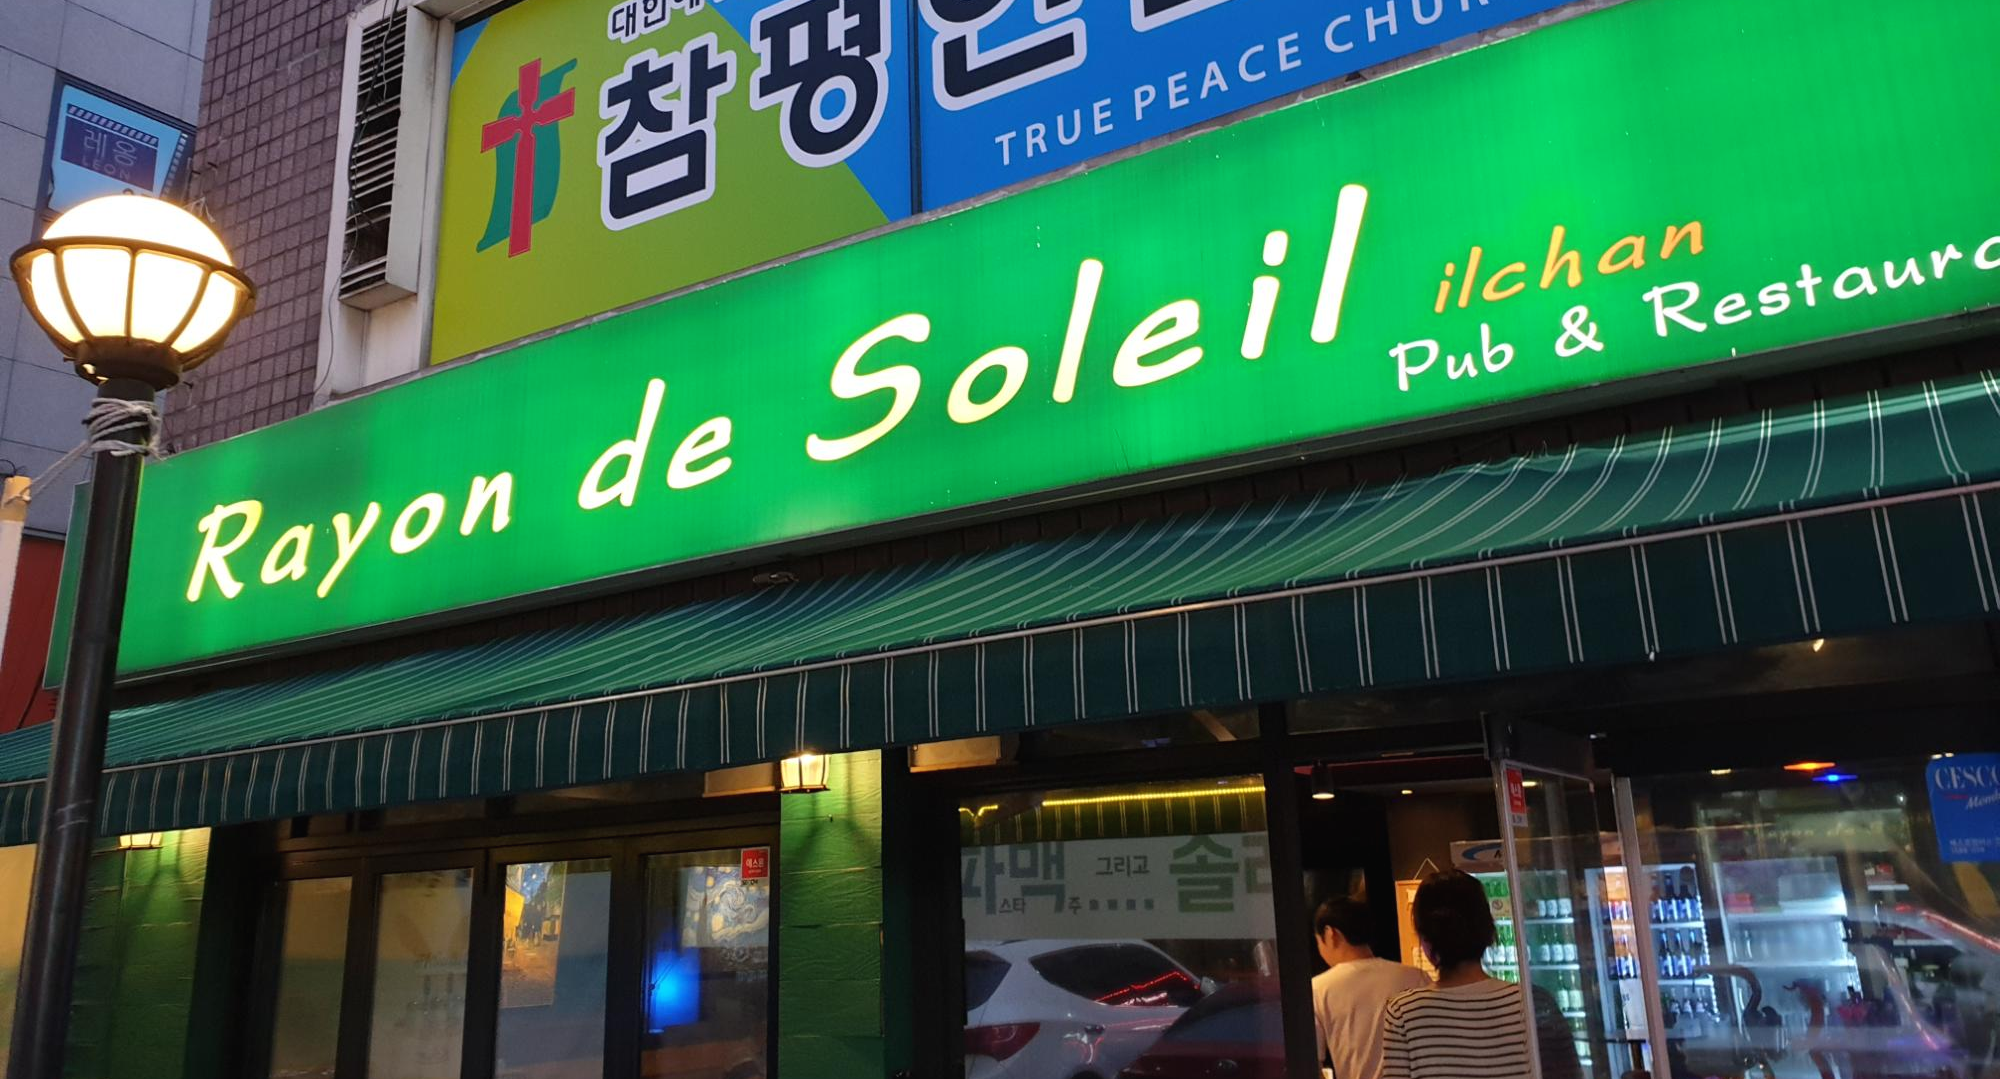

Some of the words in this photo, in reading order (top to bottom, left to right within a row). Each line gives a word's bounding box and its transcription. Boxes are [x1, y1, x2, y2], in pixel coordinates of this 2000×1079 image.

[994, 98, 1114, 166] TRUE
[1133, 32, 1302, 121] PEACE
[81, 156, 132, 180] LEON
[82, 129, 138, 167] 레옹
[1434, 221, 1704, 314] ilchan
[1388, 323, 1515, 392] Pub
[1554, 305, 1605, 358] &
[186, 472, 513, 602] Rayon
[577, 378, 732, 510] de
[805, 184, 1369, 462] Soleil
[1095, 854, 1150, 878] 그리고
[999, 897, 1026, 915] 스타
